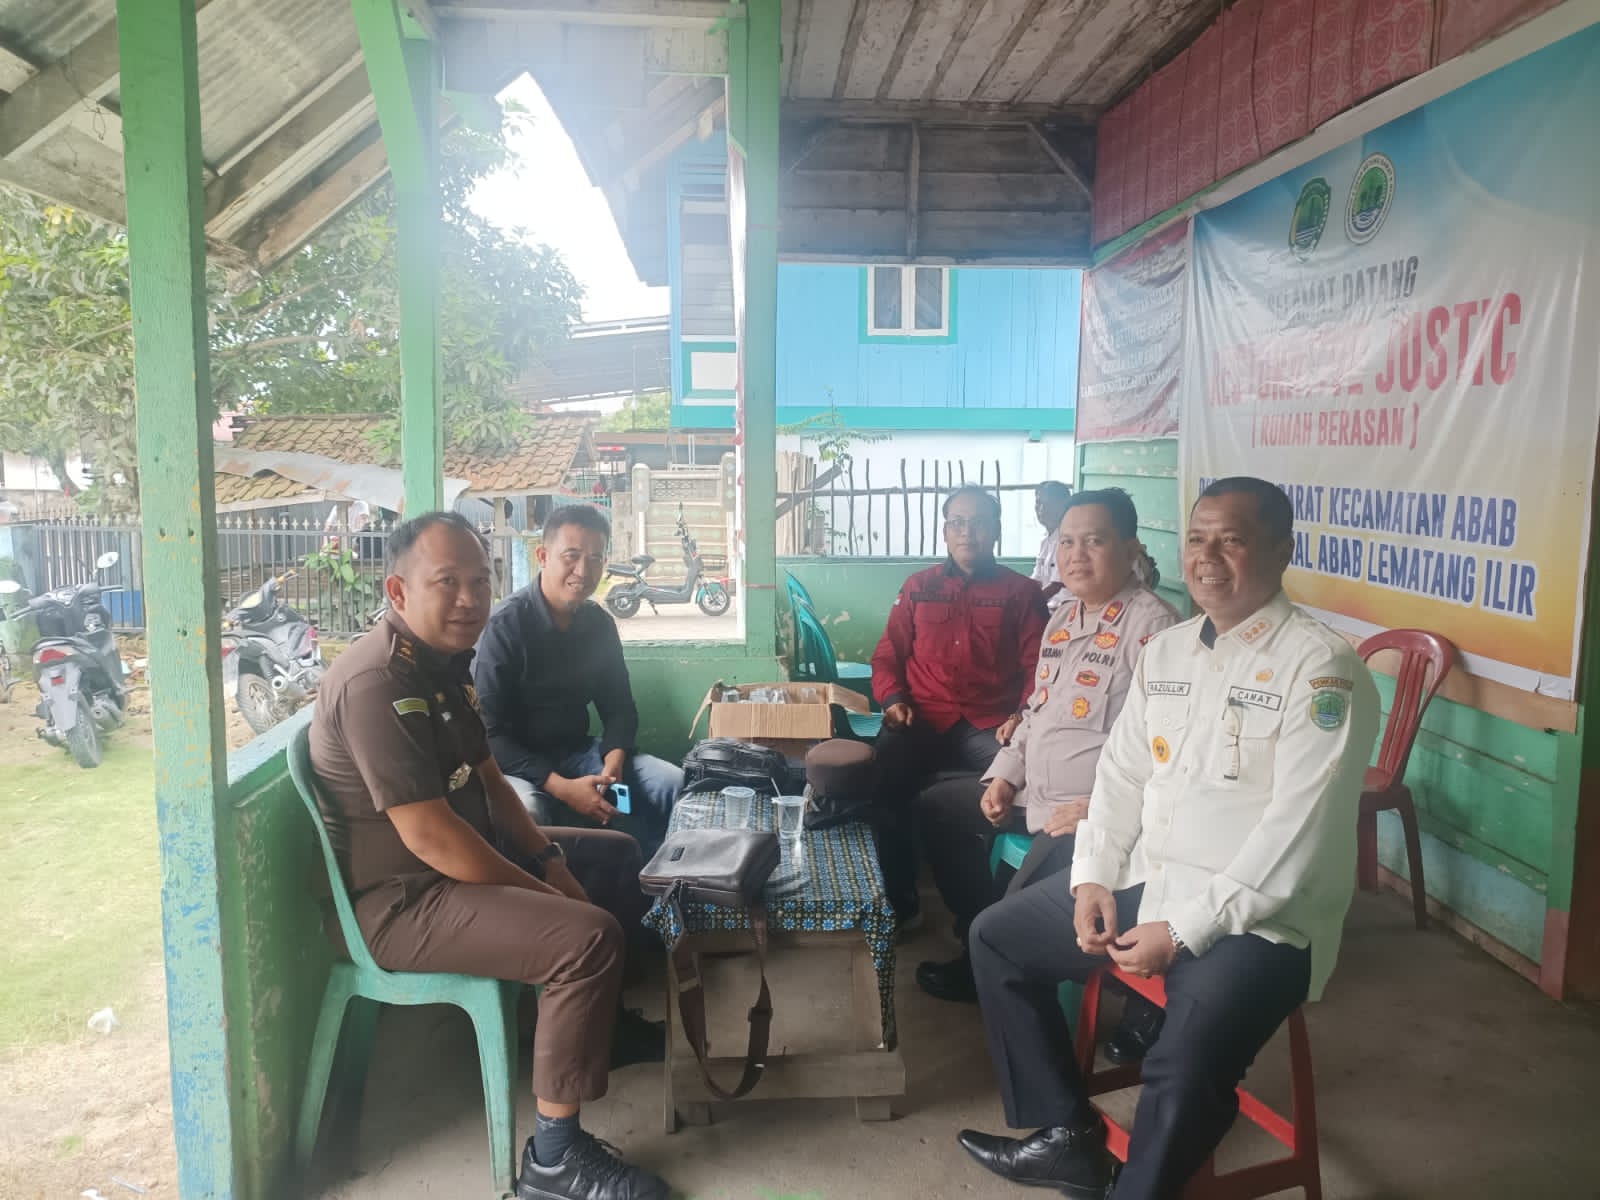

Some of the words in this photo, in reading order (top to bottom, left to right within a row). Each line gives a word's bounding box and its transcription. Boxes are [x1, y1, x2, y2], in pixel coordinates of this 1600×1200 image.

[1342, 256, 1419, 308] DATANG
[1376, 292, 1521, 394] JUSTIC
[1261, 413, 1312, 447] RUMAH
[1318, 408, 1405, 446] BERASAN
[1279, 484, 1324, 522] ARAT
[1328, 487, 1447, 538] KECAMATAN
[1451, 495, 1517, 547] ABAB
[1317, 534, 1363, 578] ABAB
[1367, 541, 1476, 603] LEMATANG
[1483, 559, 1537, 616] ILIR
[1082, 652, 1116, 667] POLRI
[1237, 691, 1272, 705] CAMAT
